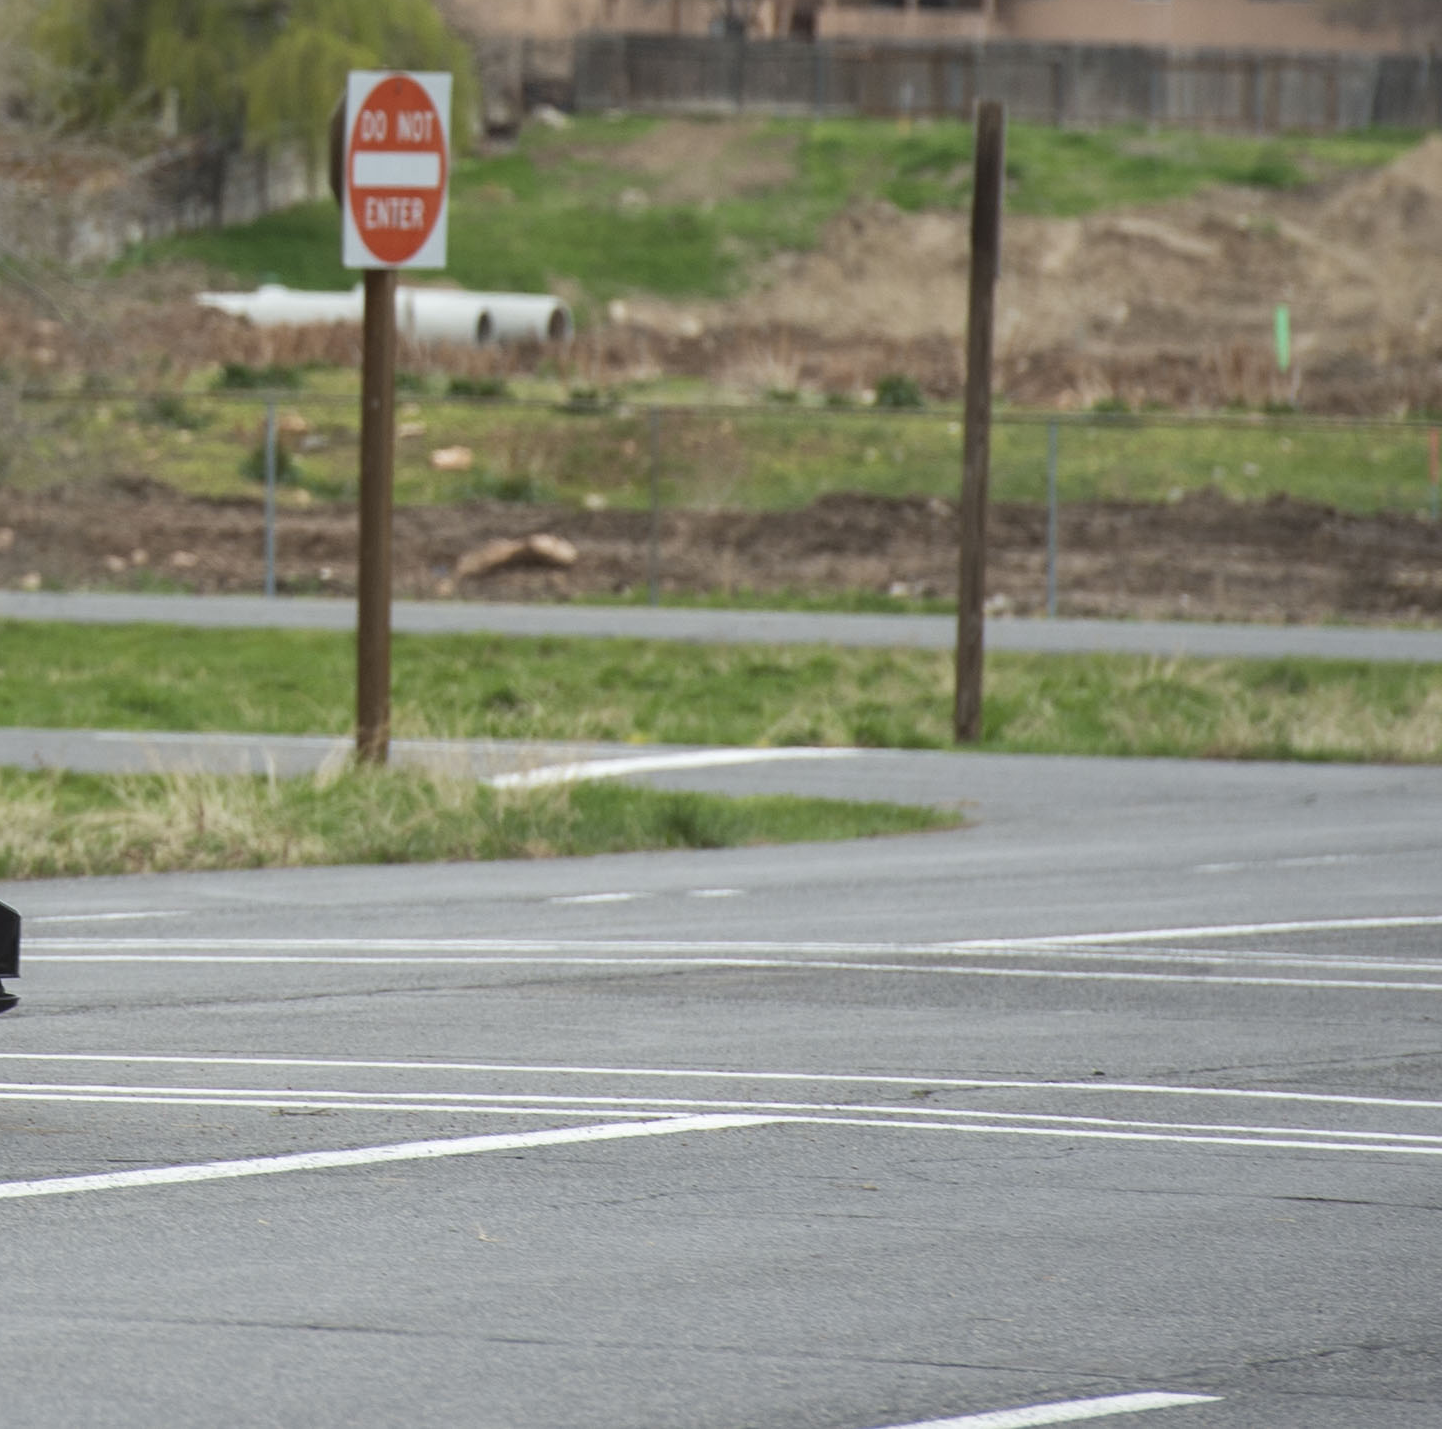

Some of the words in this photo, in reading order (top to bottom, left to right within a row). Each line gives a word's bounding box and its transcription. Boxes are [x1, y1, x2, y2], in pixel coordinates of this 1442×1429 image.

[360, 110, 387, 142] DO
[397, 111, 434, 143] NOT
[364, 198, 424, 230] ENTER
